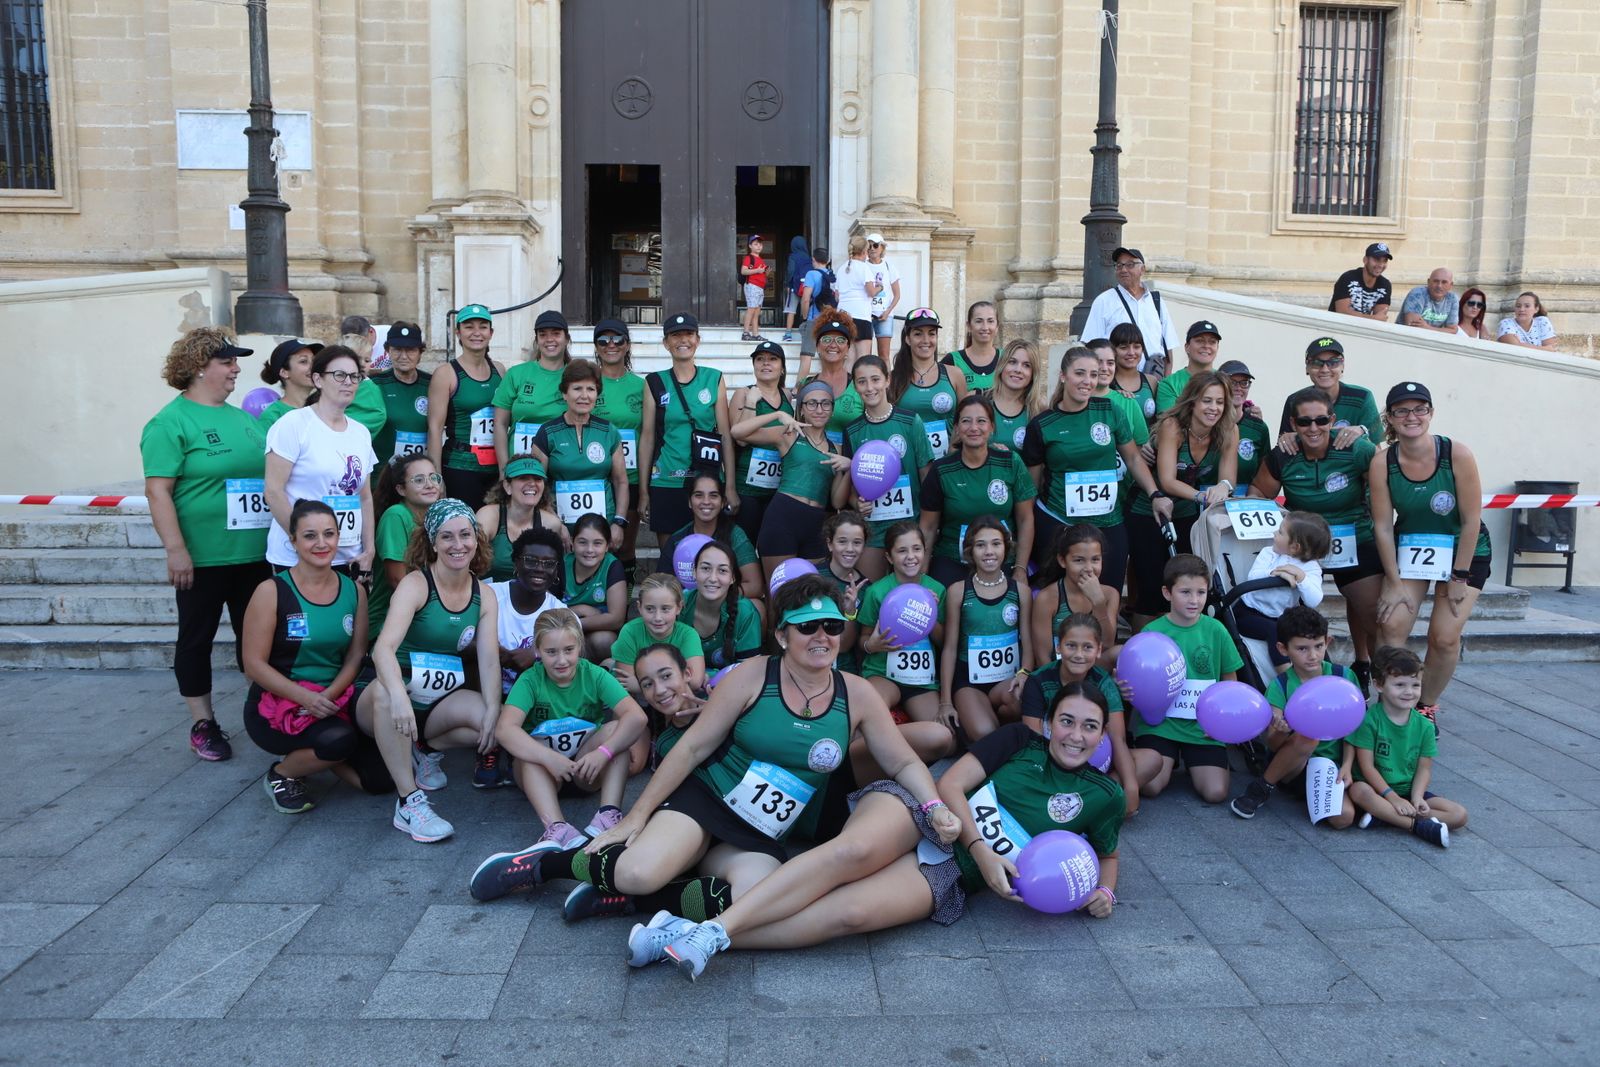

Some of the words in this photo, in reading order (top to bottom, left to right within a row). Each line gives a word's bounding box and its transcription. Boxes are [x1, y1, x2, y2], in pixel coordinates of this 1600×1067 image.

[570, 493, 593, 510] 80
[1075, 484, 1110, 502] 154
[1239, 512, 1277, 527] 616
[1410, 547, 1436, 565] 72
[907, 598, 933, 617] CARRERA
[900, 614, 928, 628] CHICLANA
[897, 651, 930, 670] 398
[978, 647, 1014, 669] 696
[422, 669, 457, 691] 180
[1181, 689, 1192, 697] OY
[544, 730, 587, 751] 187
[1328, 765, 1336, 776] NO
[1326, 776, 1334, 788] SOY
[751, 783, 797, 822] 133
[1324, 789, 1333, 814] MUJER
[975, 805, 1014, 856] 450
[1067, 858, 1086, 898] CHICLANA
[1081, 850, 1098, 888] CARRERA
